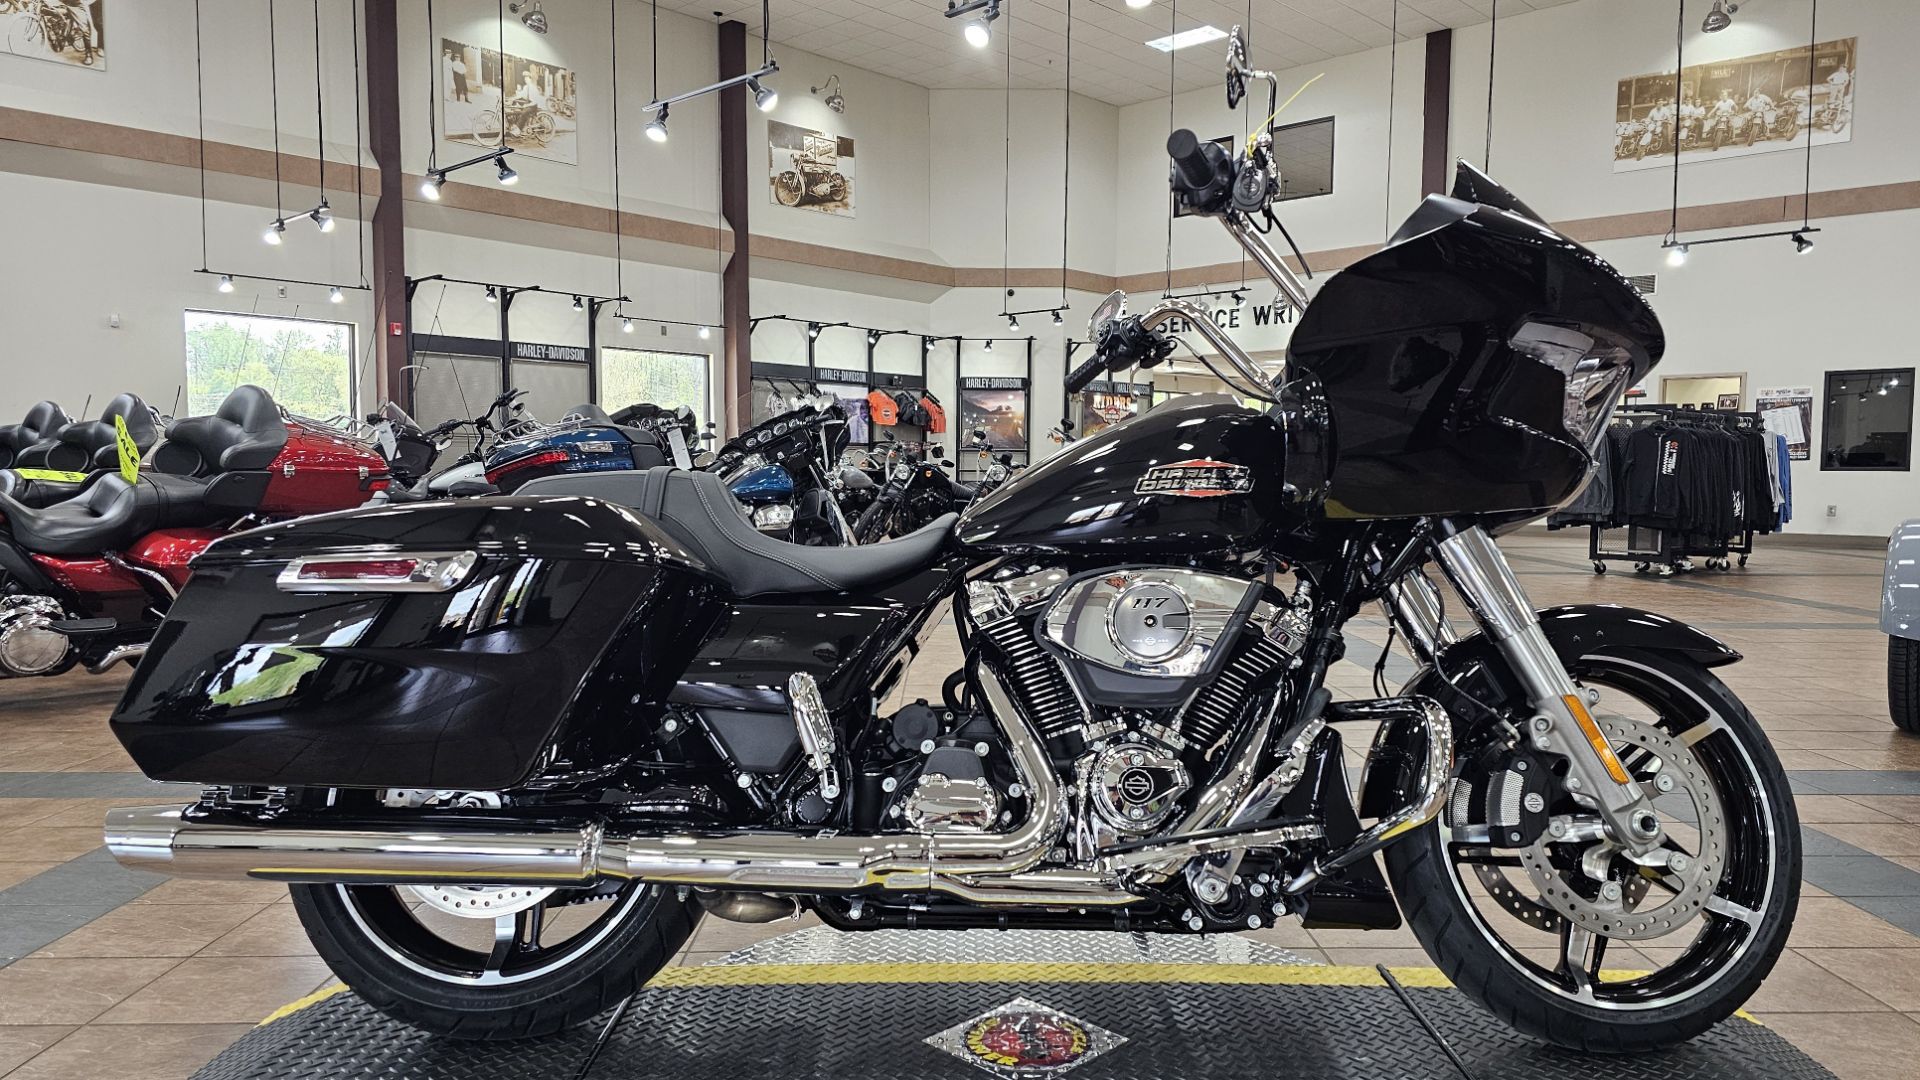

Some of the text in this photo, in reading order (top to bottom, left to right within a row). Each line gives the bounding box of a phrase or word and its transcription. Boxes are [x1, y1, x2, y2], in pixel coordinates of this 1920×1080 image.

[1157, 309, 1240, 333] SERICE
[517, 343, 585, 361] HARLEY-DAVIDSON
[1132, 597, 1171, 609] 117
